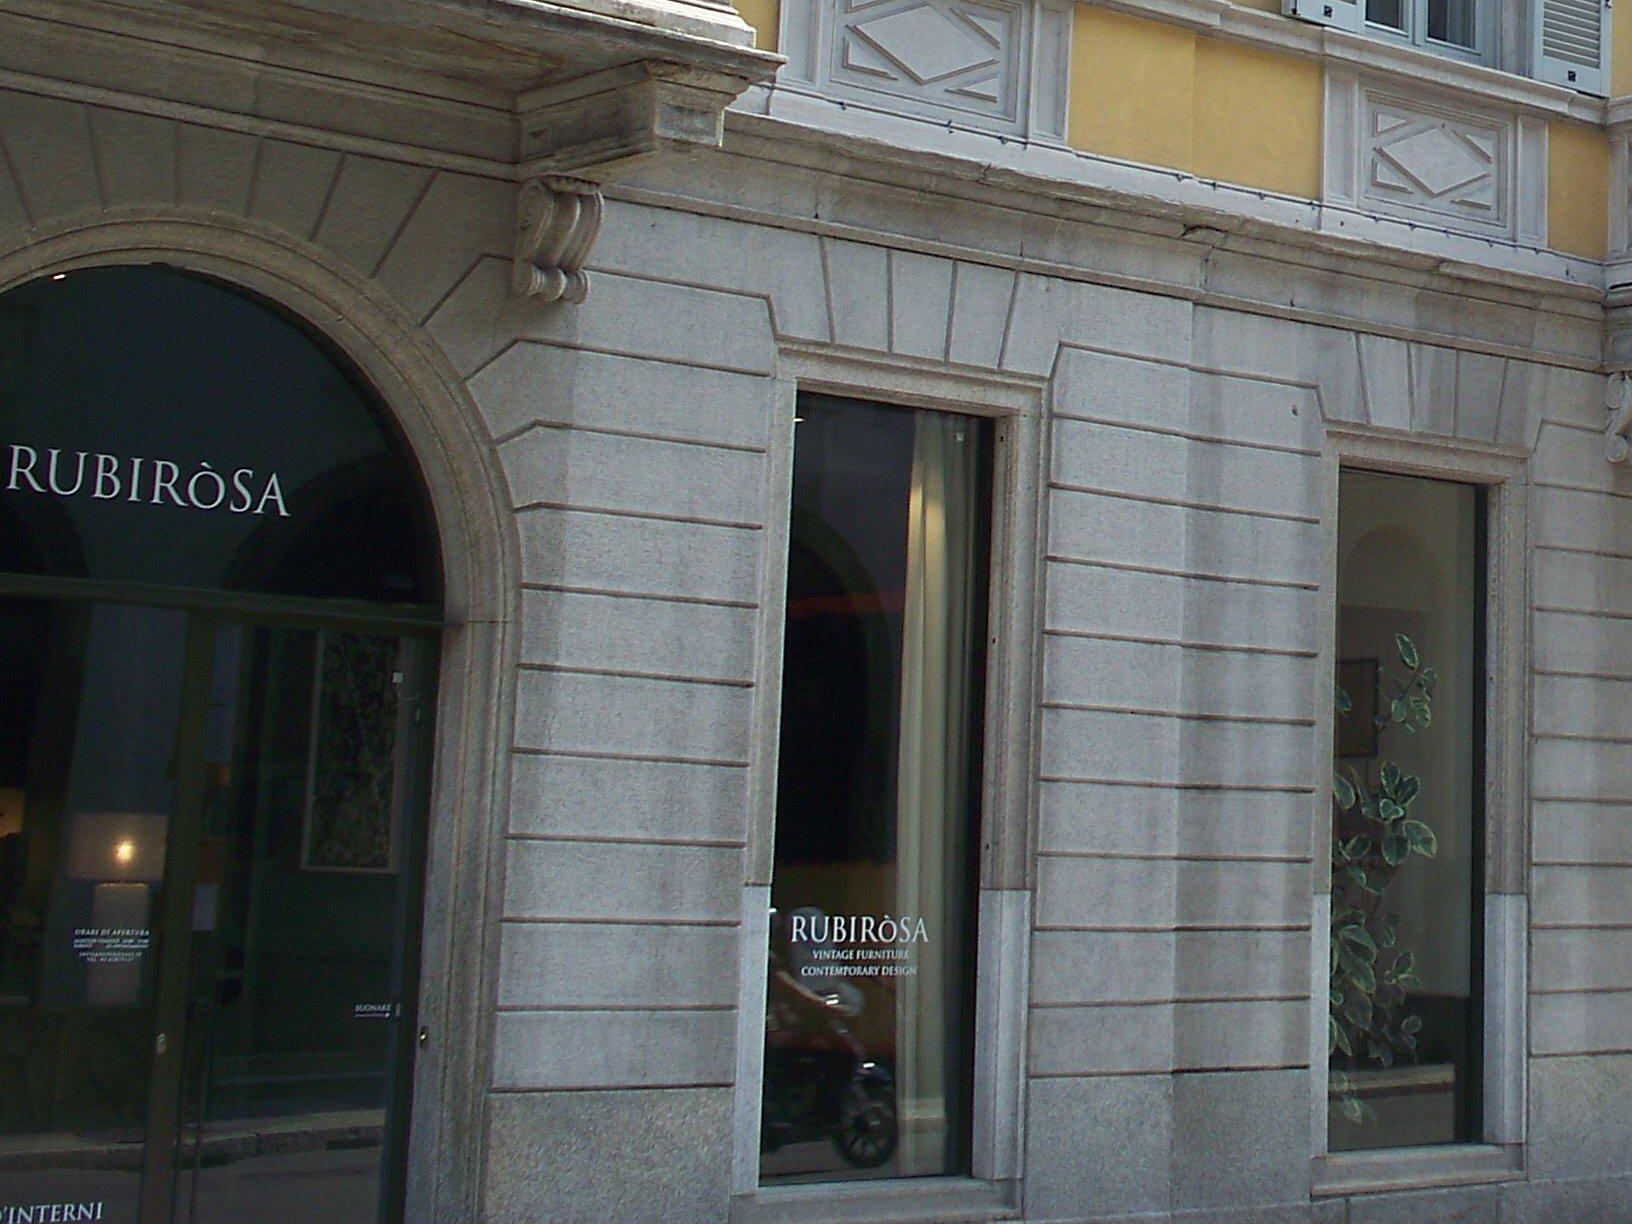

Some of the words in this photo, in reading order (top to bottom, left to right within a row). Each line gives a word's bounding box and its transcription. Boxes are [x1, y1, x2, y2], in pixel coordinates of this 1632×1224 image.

[6, 444, 292, 517] RUBIRÒSA
[791, 914, 930, 943] RUBIRÒSA
[812, 949, 855, 960] VINTAGE
[856, 949, 909, 960] FURNITURE
[801, 966, 880, 977] CONTEMPORARY
[881, 966, 917, 976] DESIGN
[0, 1202, 103, 1223] 'INTERNI
